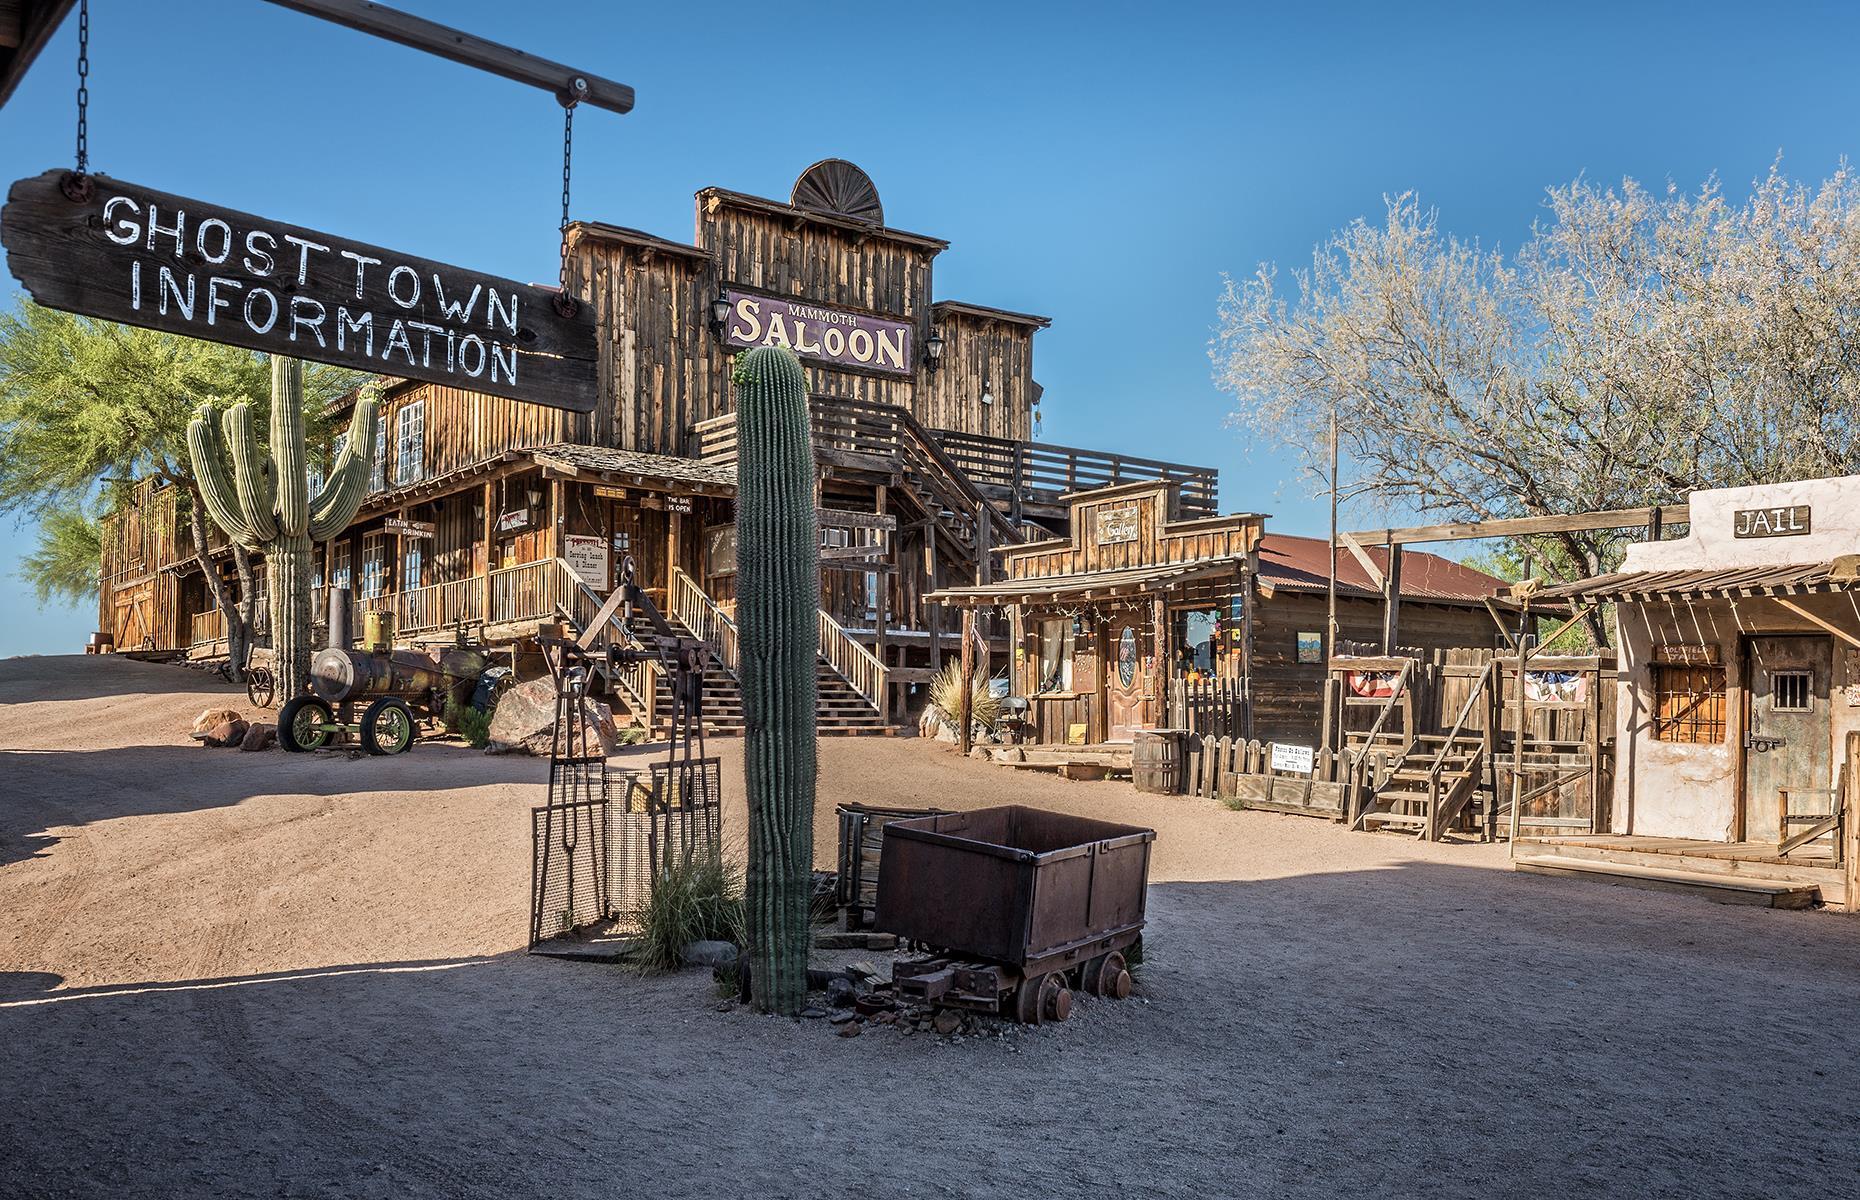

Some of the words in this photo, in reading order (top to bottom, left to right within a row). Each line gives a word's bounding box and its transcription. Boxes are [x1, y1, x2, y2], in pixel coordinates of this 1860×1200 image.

[102, 196, 330, 285] GHOST
[341, 250, 518, 336] TOWN
[132, 261, 518, 386] INFORMATION
[788, 303, 857, 327] MAMMOTH
[731, 299, 907, 370] SALOON
[667, 496, 678, 504] THE
[679, 497, 690, 505] BAR
[1107, 521, 1137, 538] Gallery
[1736, 507, 1804, 535] JAIL
[1670, 653, 1698, 661] JAIL
